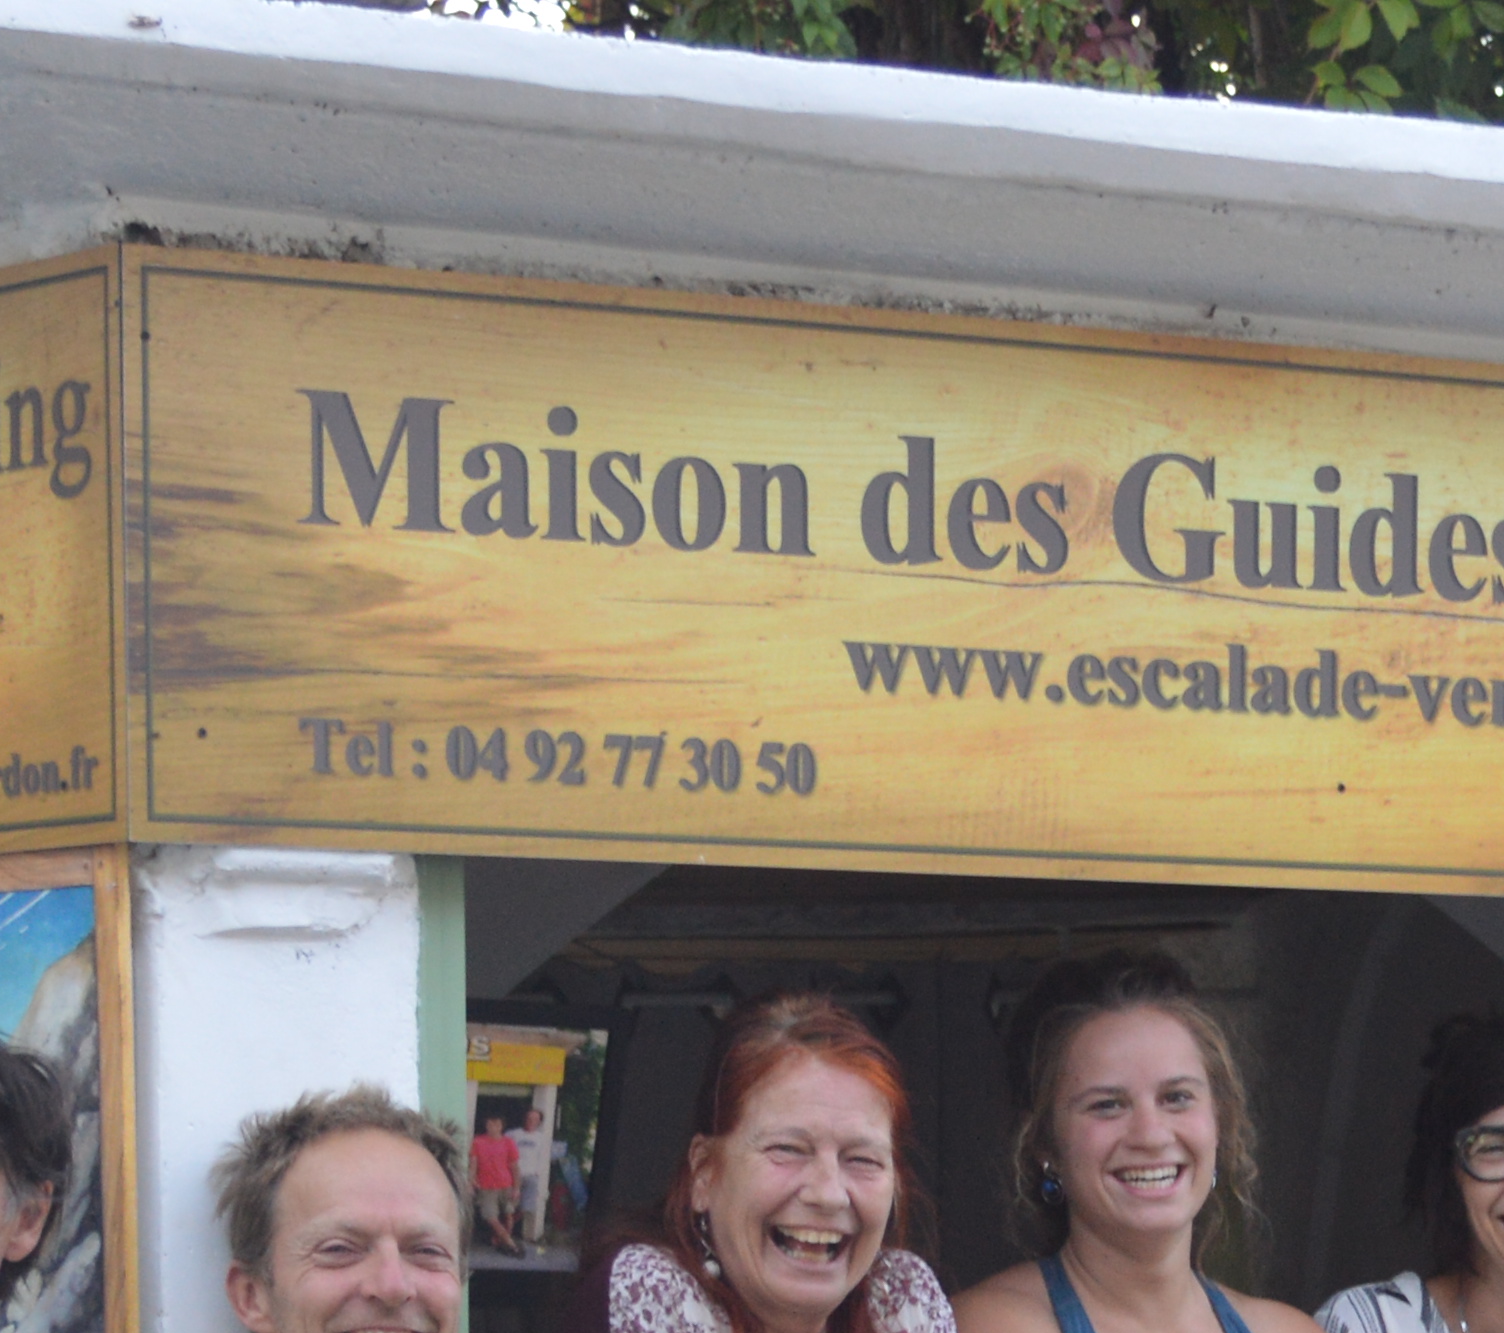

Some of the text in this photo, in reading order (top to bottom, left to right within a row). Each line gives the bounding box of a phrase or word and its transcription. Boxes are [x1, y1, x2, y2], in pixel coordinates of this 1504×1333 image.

[295, 387, 816, 557] Maison
[859, 435, 1070, 574] des
[299, 717, 816, 798] Tel : 04 92 77 30 50
